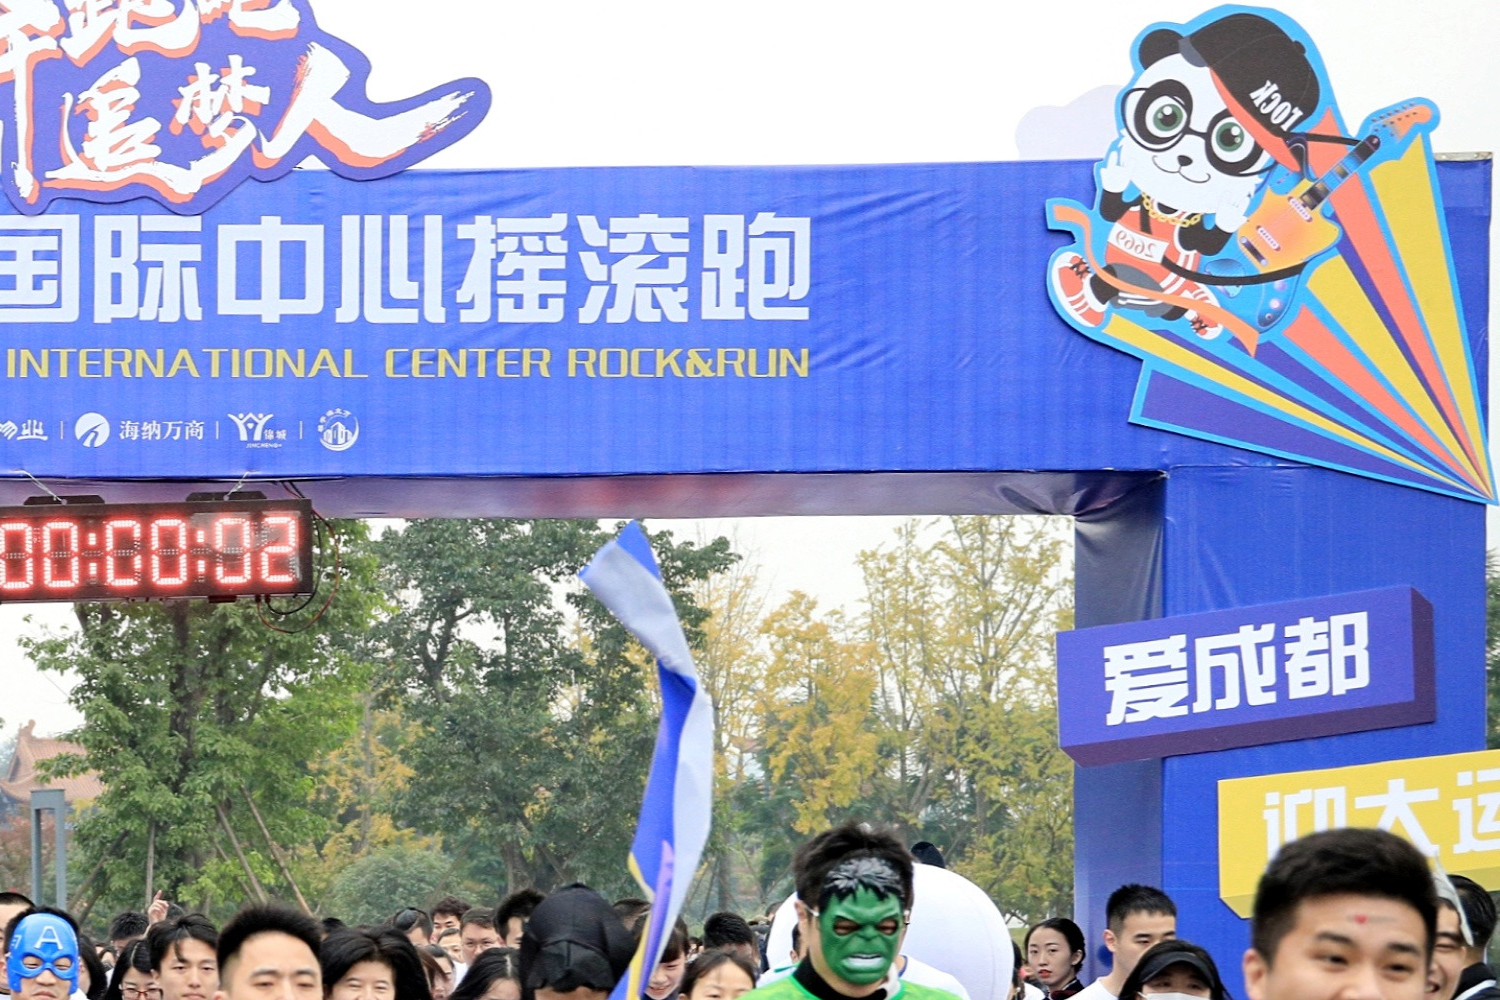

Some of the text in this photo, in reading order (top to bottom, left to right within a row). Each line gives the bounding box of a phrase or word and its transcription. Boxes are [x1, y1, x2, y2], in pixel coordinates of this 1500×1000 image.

[43, 42, 476, 196] 追梦人
[6, 347, 369, 379] INTERNATIONAL
[384, 347, 552, 379] CENTER
[567, 347, 810, 379] ROCK&RUN
[118, 420, 205, 441] 海纳万商
[1103, 611, 1370, 726] 爱成都
[34, 926, 64, 950] A
